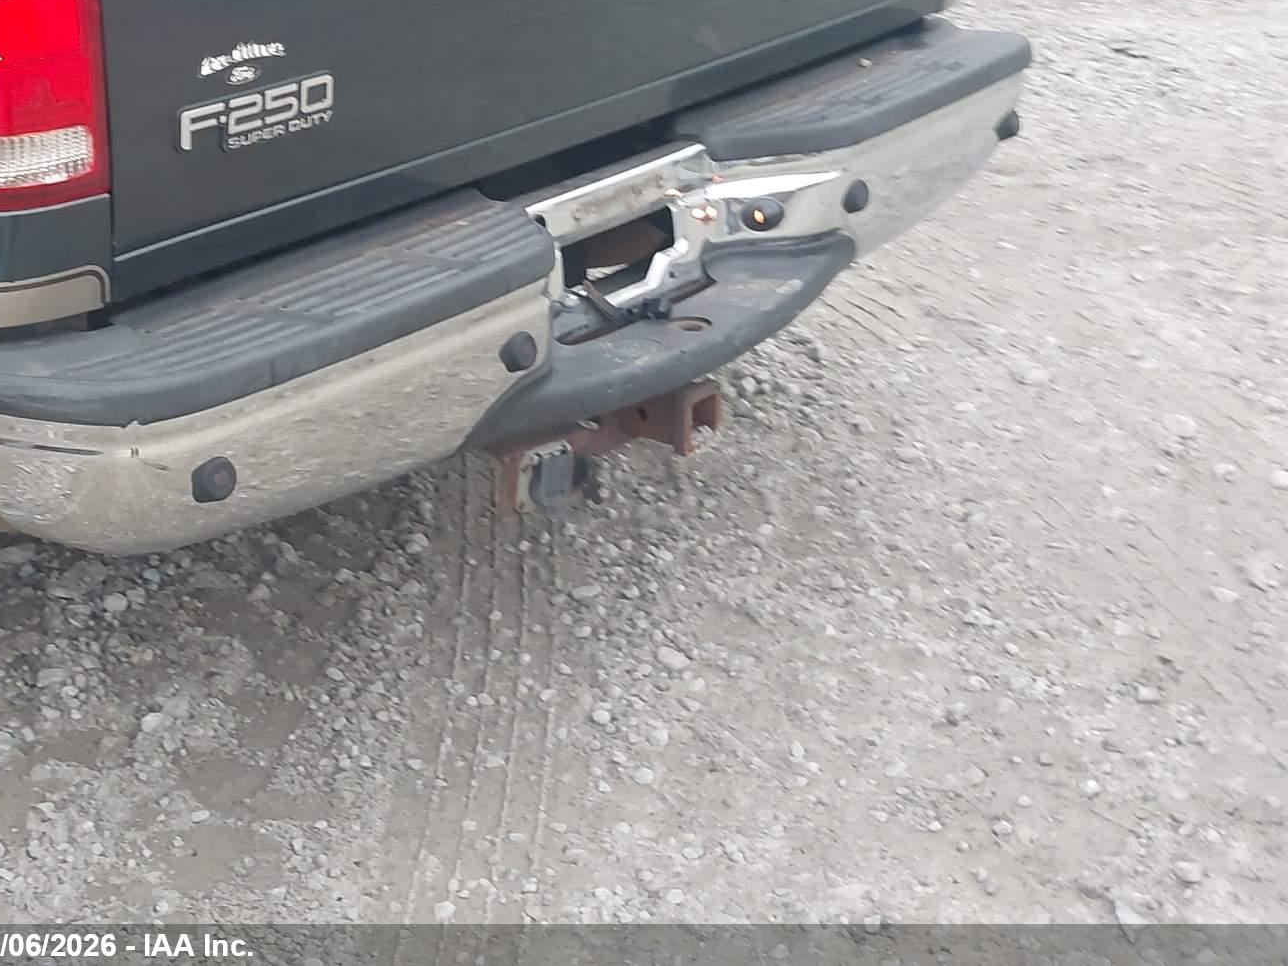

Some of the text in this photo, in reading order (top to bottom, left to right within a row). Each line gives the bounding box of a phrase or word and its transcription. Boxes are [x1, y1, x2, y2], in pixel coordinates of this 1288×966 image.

[180, 74, 335, 151] F-250
[227, 110, 334, 150] SUPER DUTY
